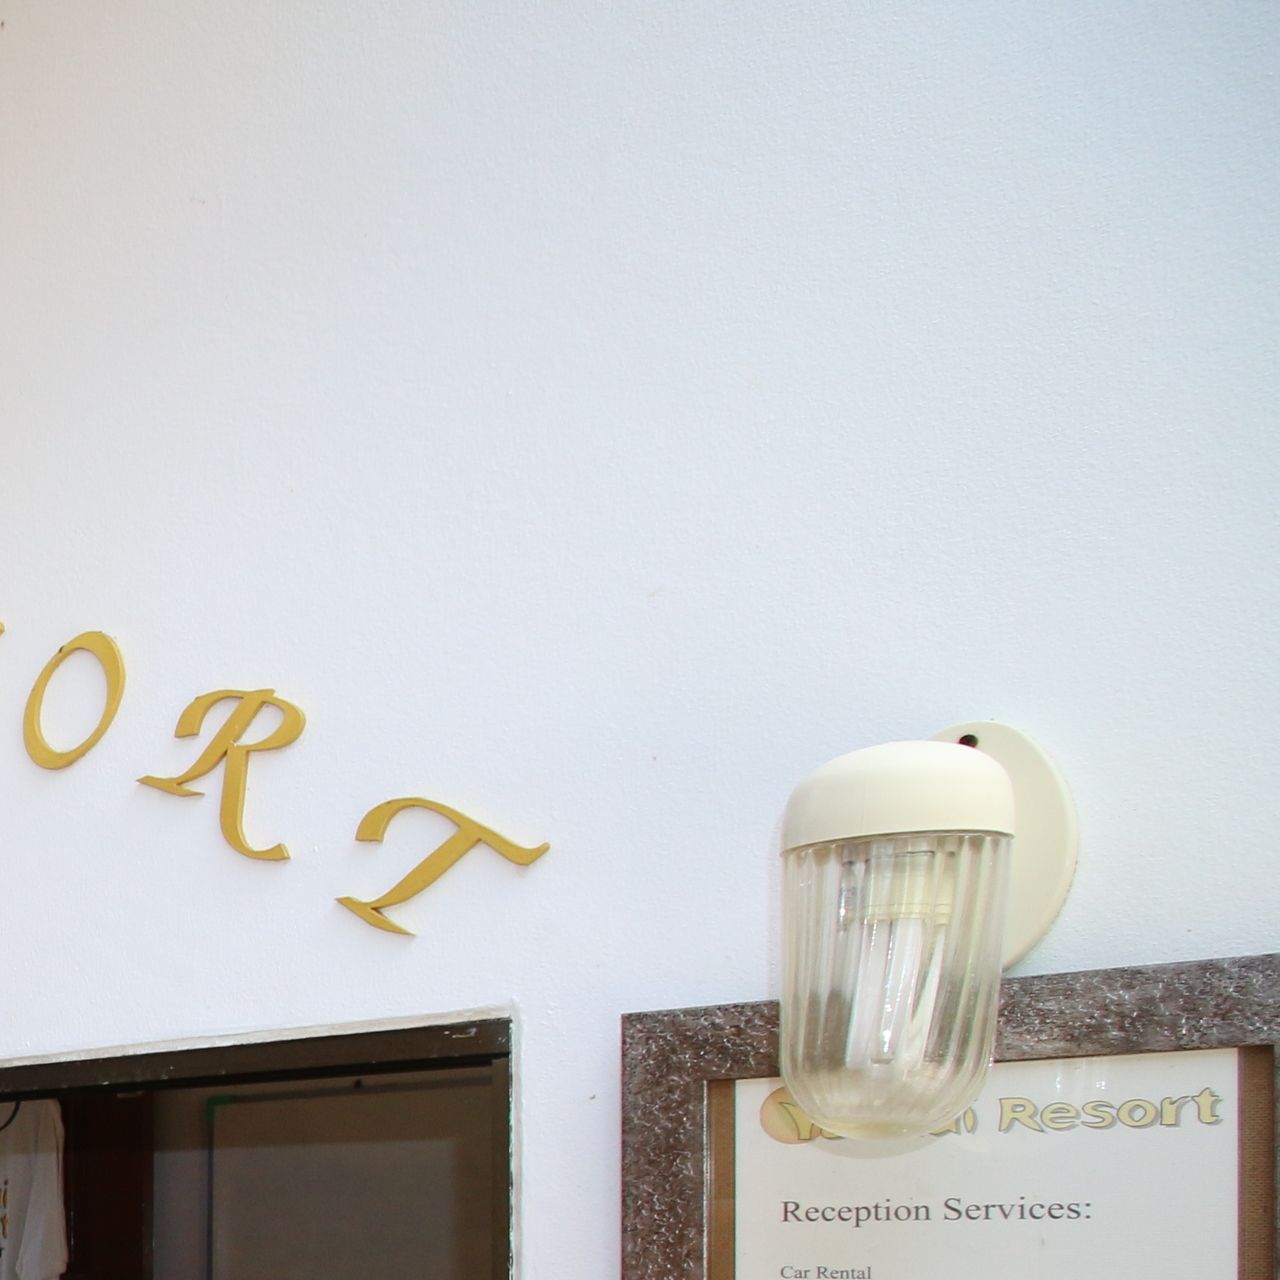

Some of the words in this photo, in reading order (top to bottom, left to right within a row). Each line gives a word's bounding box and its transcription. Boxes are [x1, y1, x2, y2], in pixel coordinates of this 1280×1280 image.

[998, 1086, 1224, 1135] Resort
[781, 1199, 932, 1228] Reception
[943, 1197, 1093, 1222] Services:
[780, 1266, 810, 1280] Car
[816, 1266, 872, 1280] Rental
